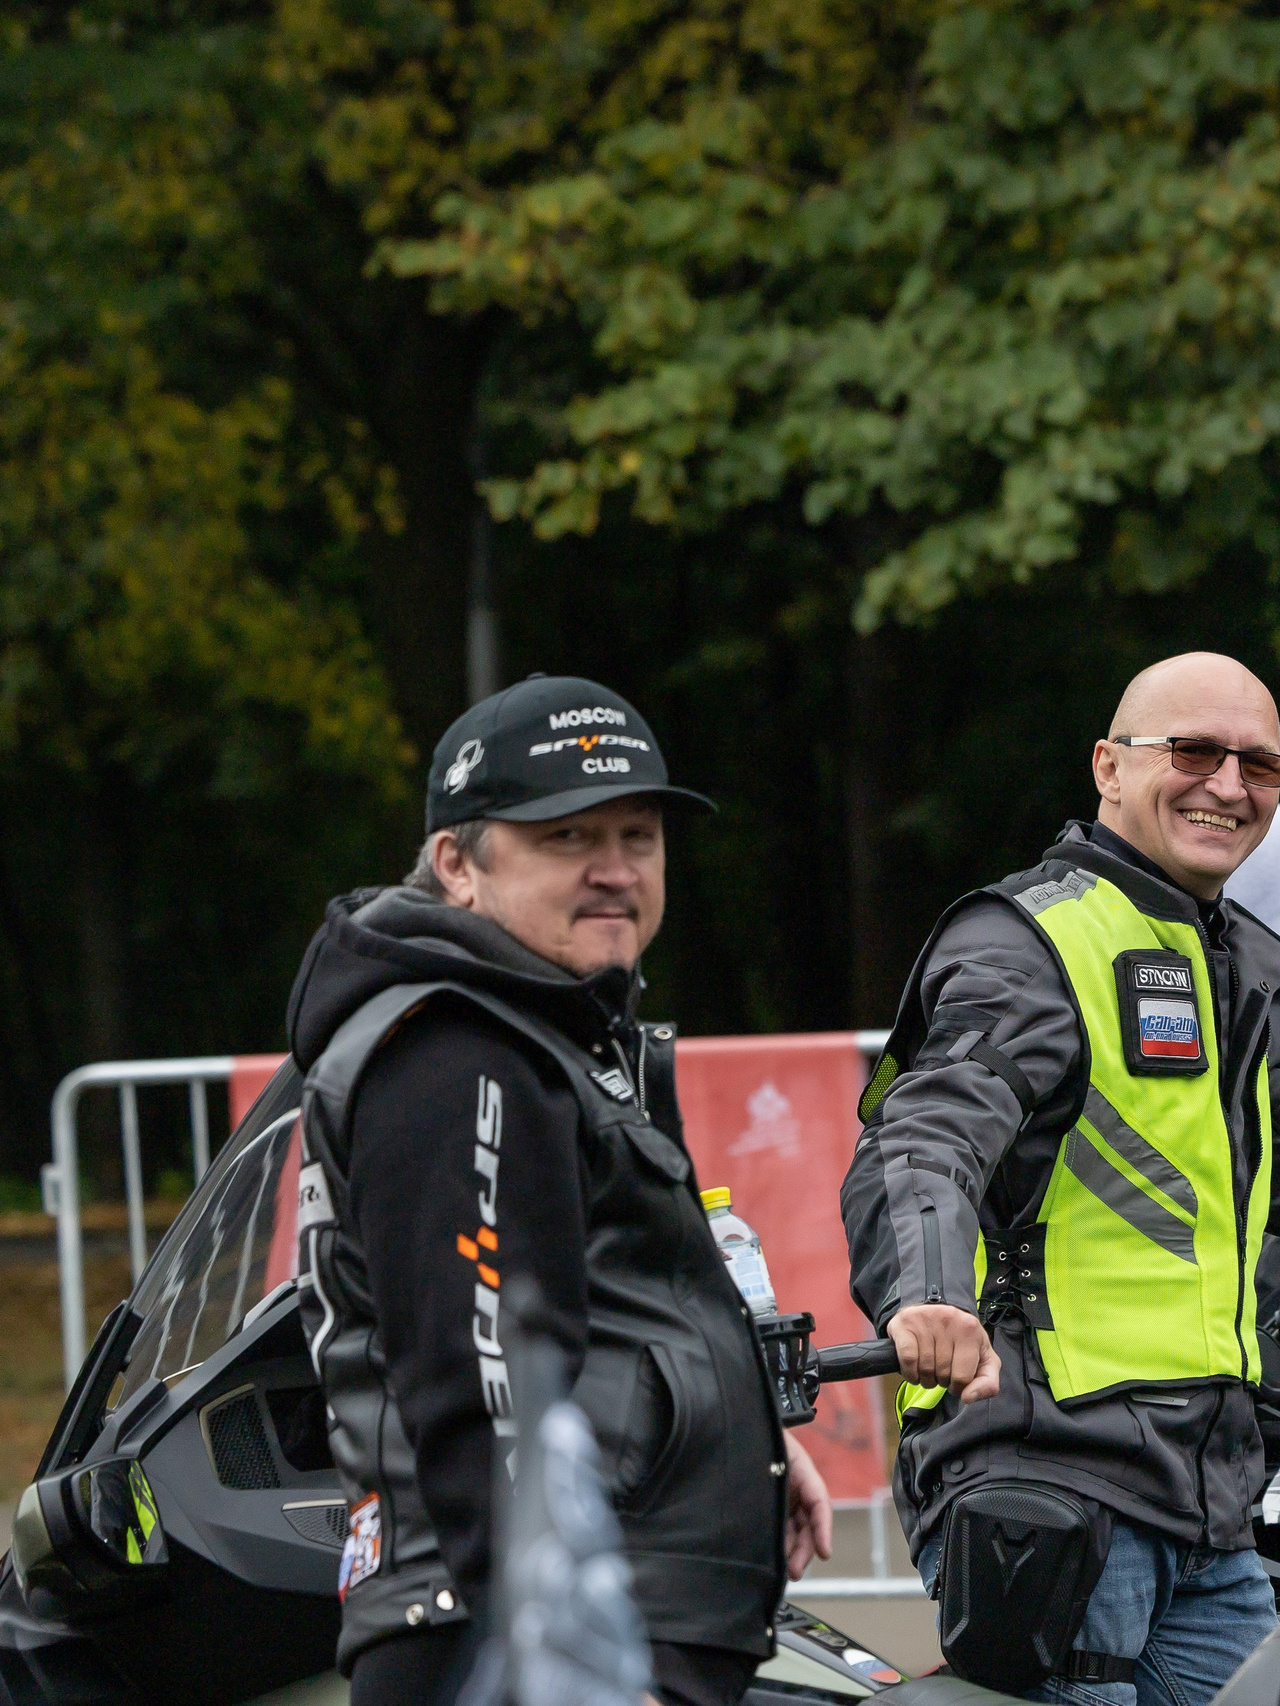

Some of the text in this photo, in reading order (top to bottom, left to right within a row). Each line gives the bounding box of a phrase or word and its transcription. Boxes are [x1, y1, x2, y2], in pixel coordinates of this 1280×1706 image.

[549, 706, 627, 731] MOSCOW
[528, 733, 650, 757] SPYDER
[581, 757, 631, 774] CLUB
